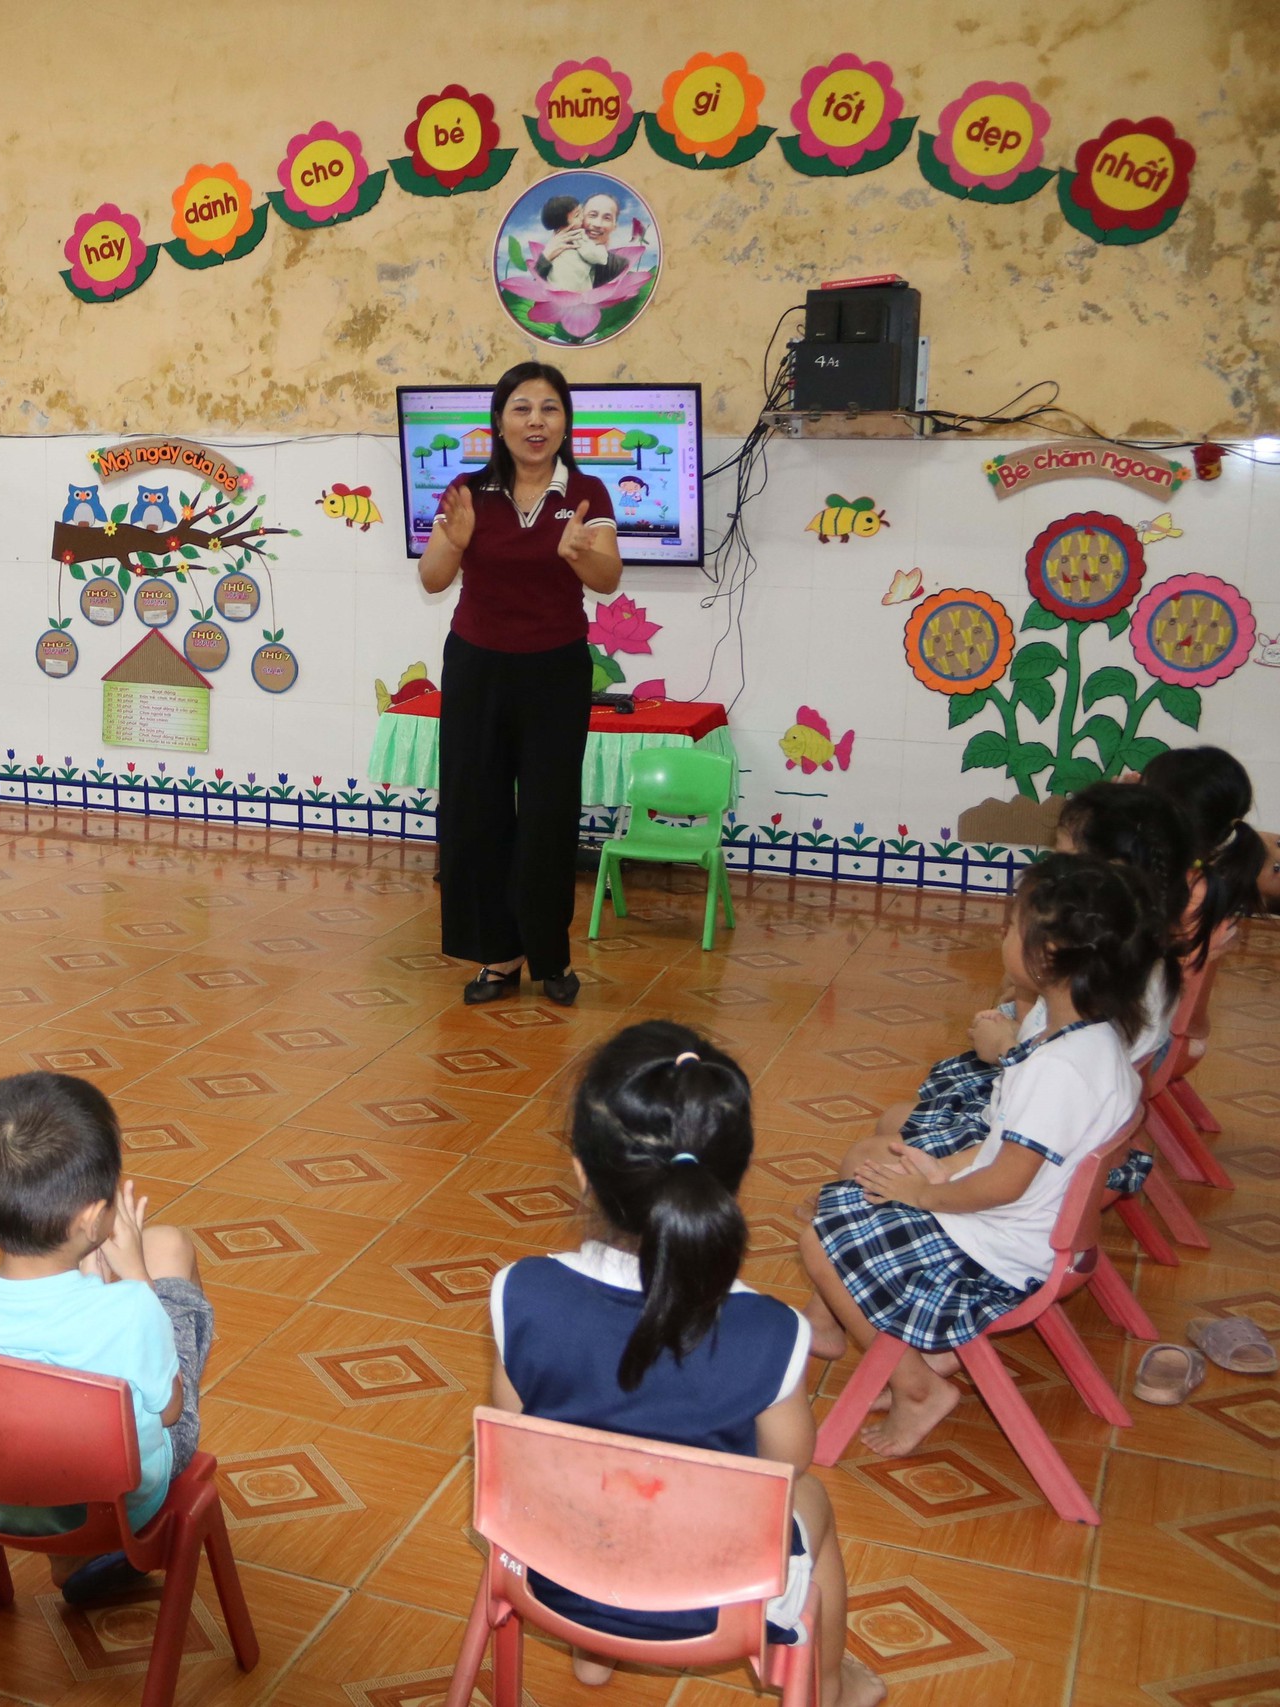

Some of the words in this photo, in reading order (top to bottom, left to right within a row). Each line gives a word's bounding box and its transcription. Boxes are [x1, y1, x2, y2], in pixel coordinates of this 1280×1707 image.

[84, 235, 126, 265] hãy
[300, 159, 344, 187] cho
[434, 118, 465, 147] bé
[692, 82, 722, 116] gì
[822, 91, 865, 124] tốt
[966, 116, 1022, 154] đẹp
[1095, 151, 1170, 193] nhất
[213, 463, 238, 491] bé
[997, 461, 1031, 489] Bé
[1033, 448, 1097, 470] chăm
[1101, 451, 1173, 487] ngoan
[164, 591, 173, 600] 4
[246, 583, 255, 594] 5
[215, 632, 224, 641] 6
